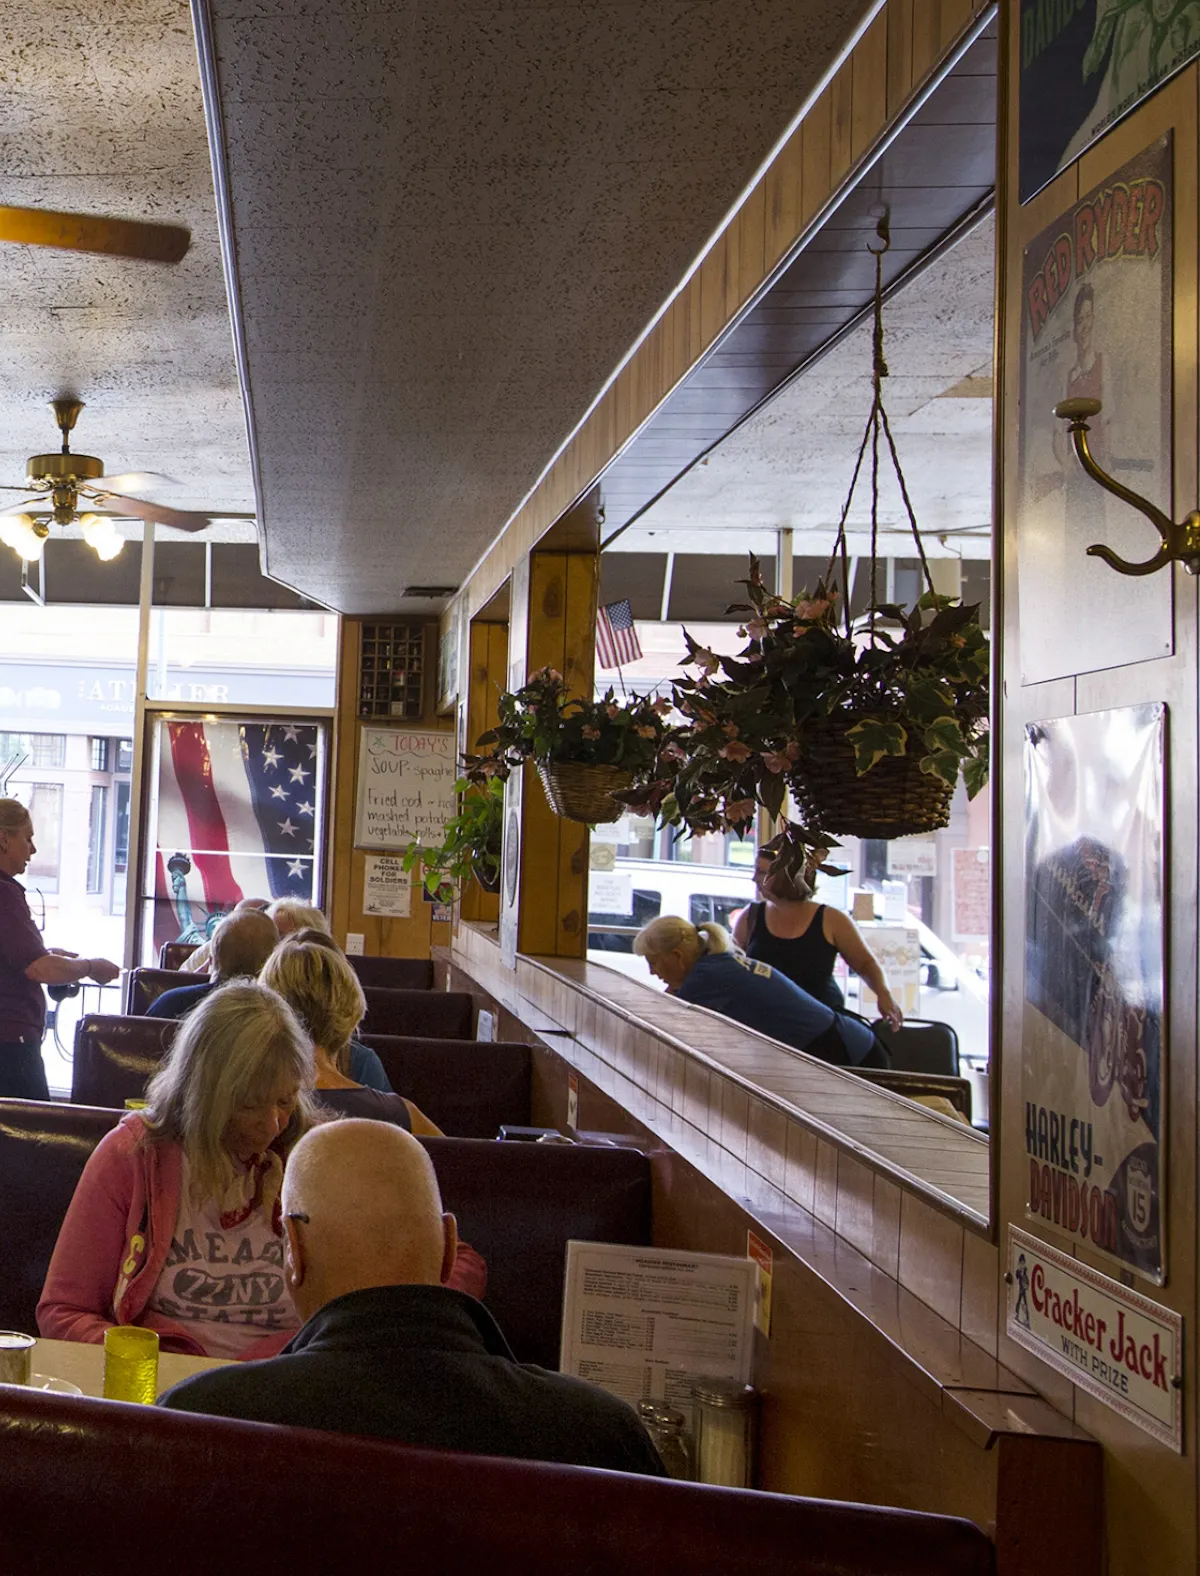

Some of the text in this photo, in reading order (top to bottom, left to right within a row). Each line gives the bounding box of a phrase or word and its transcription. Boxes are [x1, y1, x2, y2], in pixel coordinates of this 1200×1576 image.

[1022, 0, 1088, 70] DAVI
[1027, 181, 1165, 338] RED RYDER
[393, 735, 449, 753] TODAY'S
[367, 808, 410, 822] mashed
[368, 787, 398, 807] Fried
[401, 790, 423, 808] cod
[368, 876, 409, 885] SOLDIERS
[380, 858, 400, 866] CELL
[1026, 1102, 1103, 1177] HARLEY-
[1030, 1159, 1118, 1249] DAVIDSON
[1132, 1189, 1147, 1224] 15
[1031, 1263, 1169, 1393] Cracker Jack
[1061, 1335, 1129, 1393] WITH PRIZE
